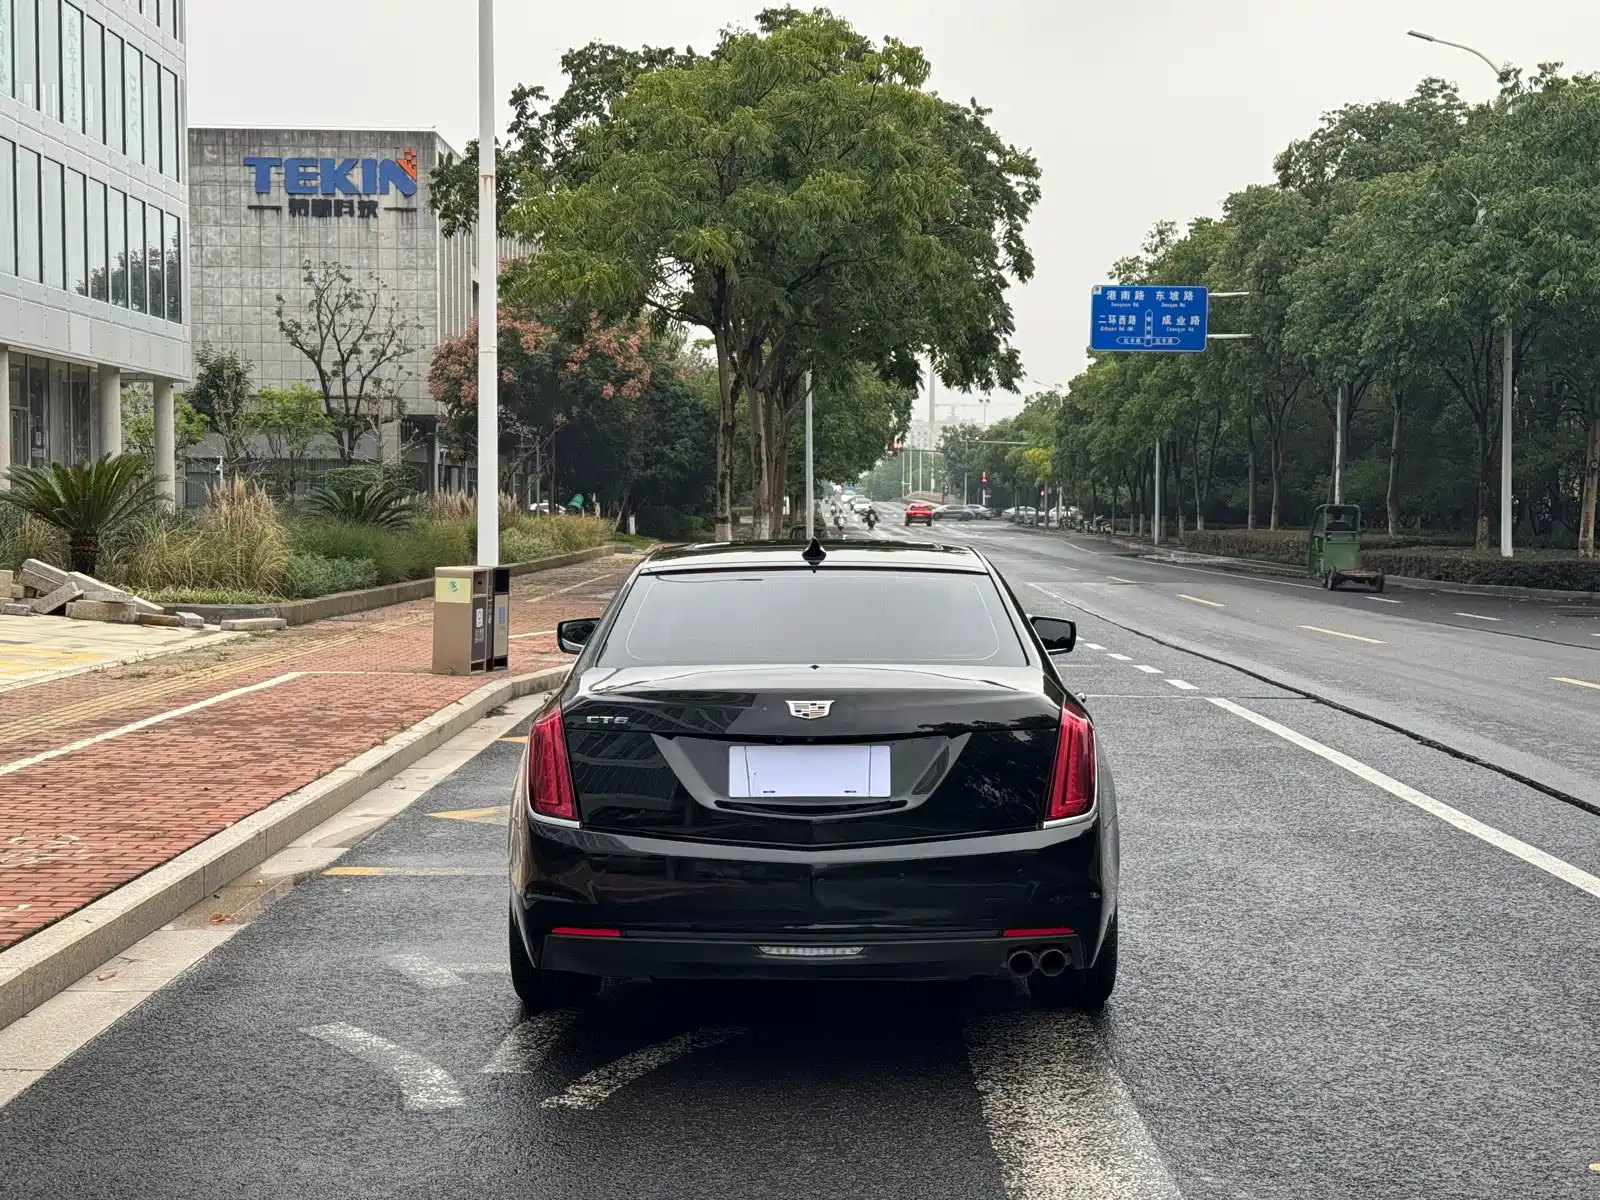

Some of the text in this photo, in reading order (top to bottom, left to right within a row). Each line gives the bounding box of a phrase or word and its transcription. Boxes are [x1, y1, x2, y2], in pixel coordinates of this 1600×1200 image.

[244, 148, 417, 198] TEKIN
[1156, 290, 1194, 301] 东坡路
[1098, 314, 1137, 326] 二环西路
[1161, 314, 1200, 326] 成业路
[586, 715, 629, 724] CT6
